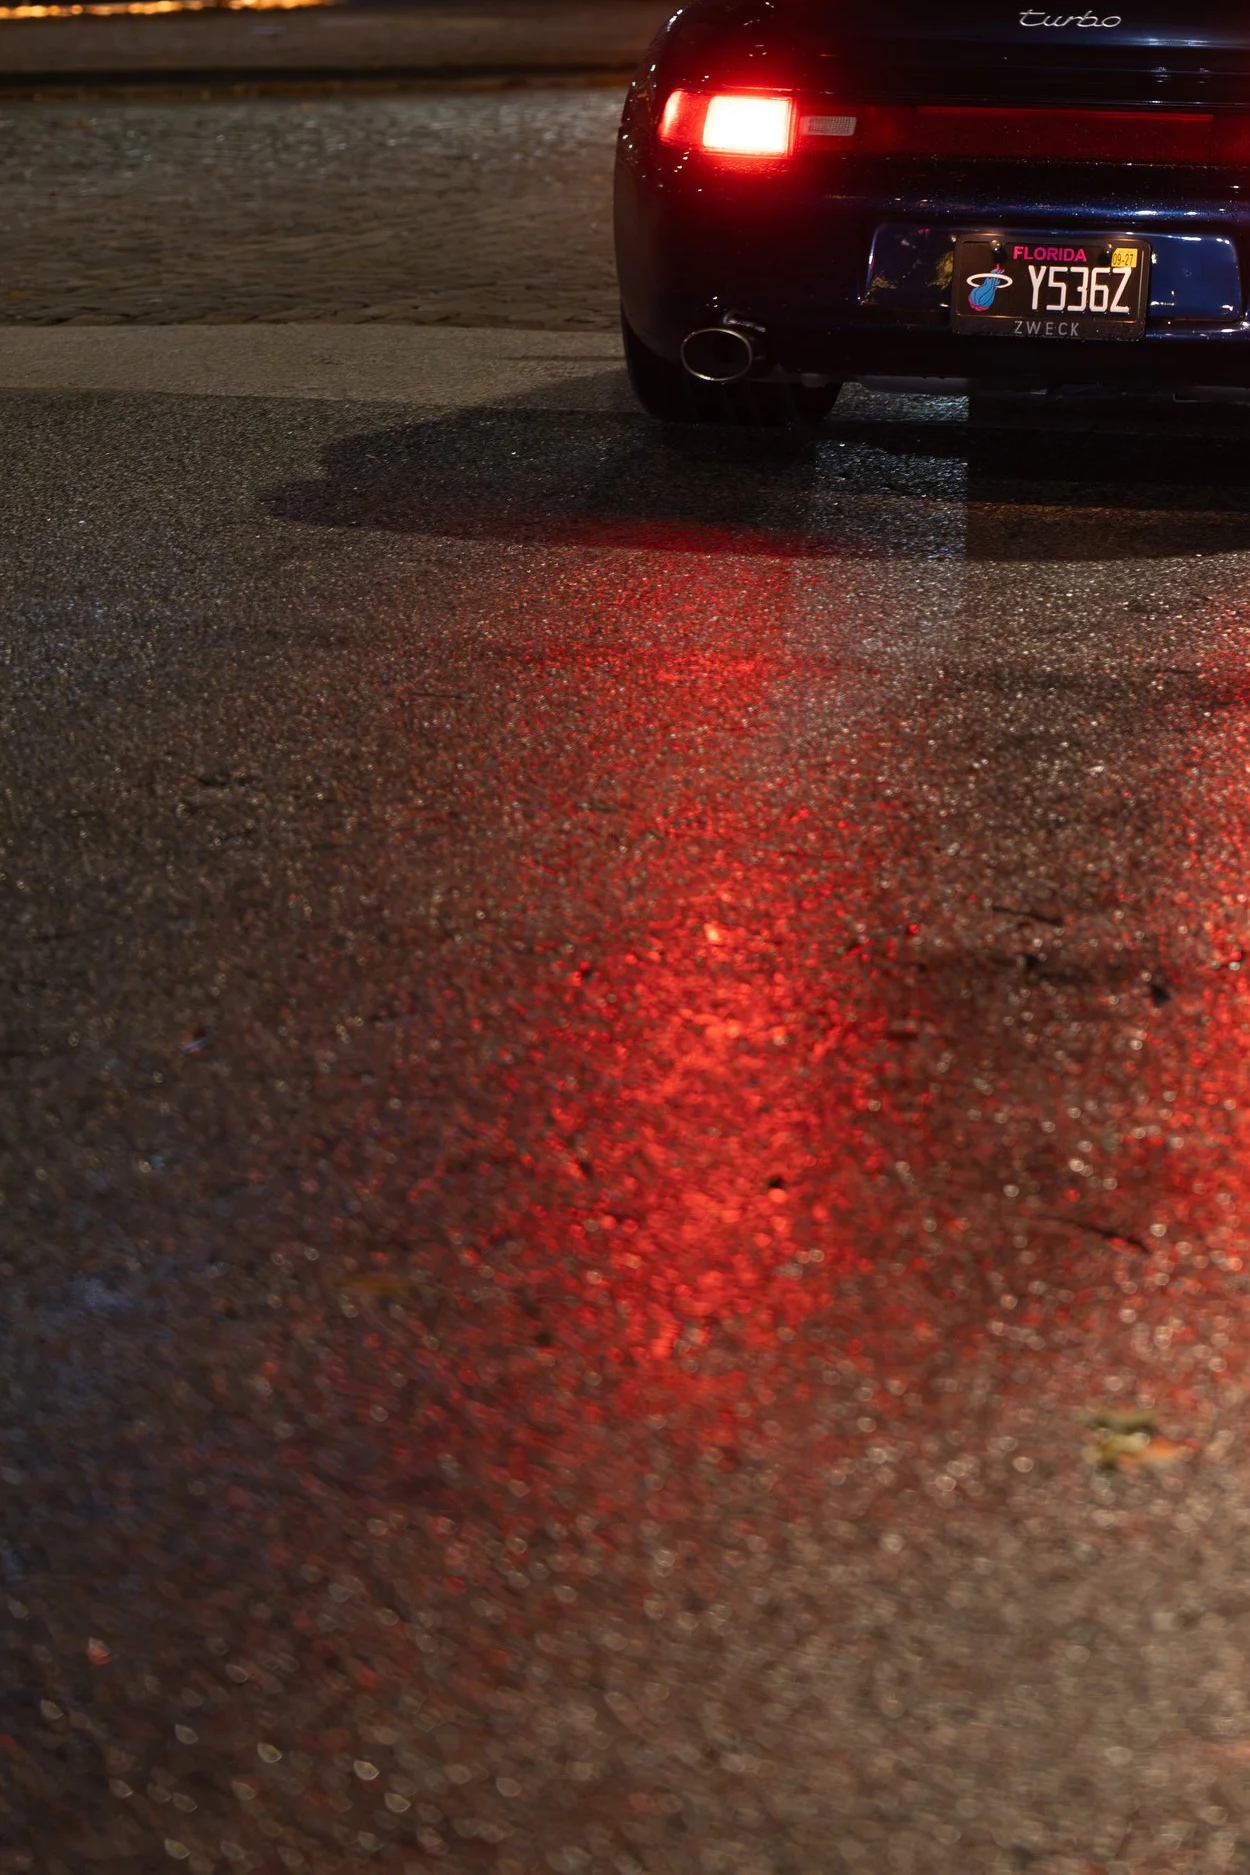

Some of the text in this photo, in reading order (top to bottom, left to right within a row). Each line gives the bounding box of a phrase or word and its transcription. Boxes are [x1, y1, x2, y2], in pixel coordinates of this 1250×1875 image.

[1019, 9, 1121, 27] turbo
[1013, 246, 1087, 262] FLORIDA
[1028, 265, 1132, 313] Y536Z
[1014, 320, 1079, 336] ZWECK
